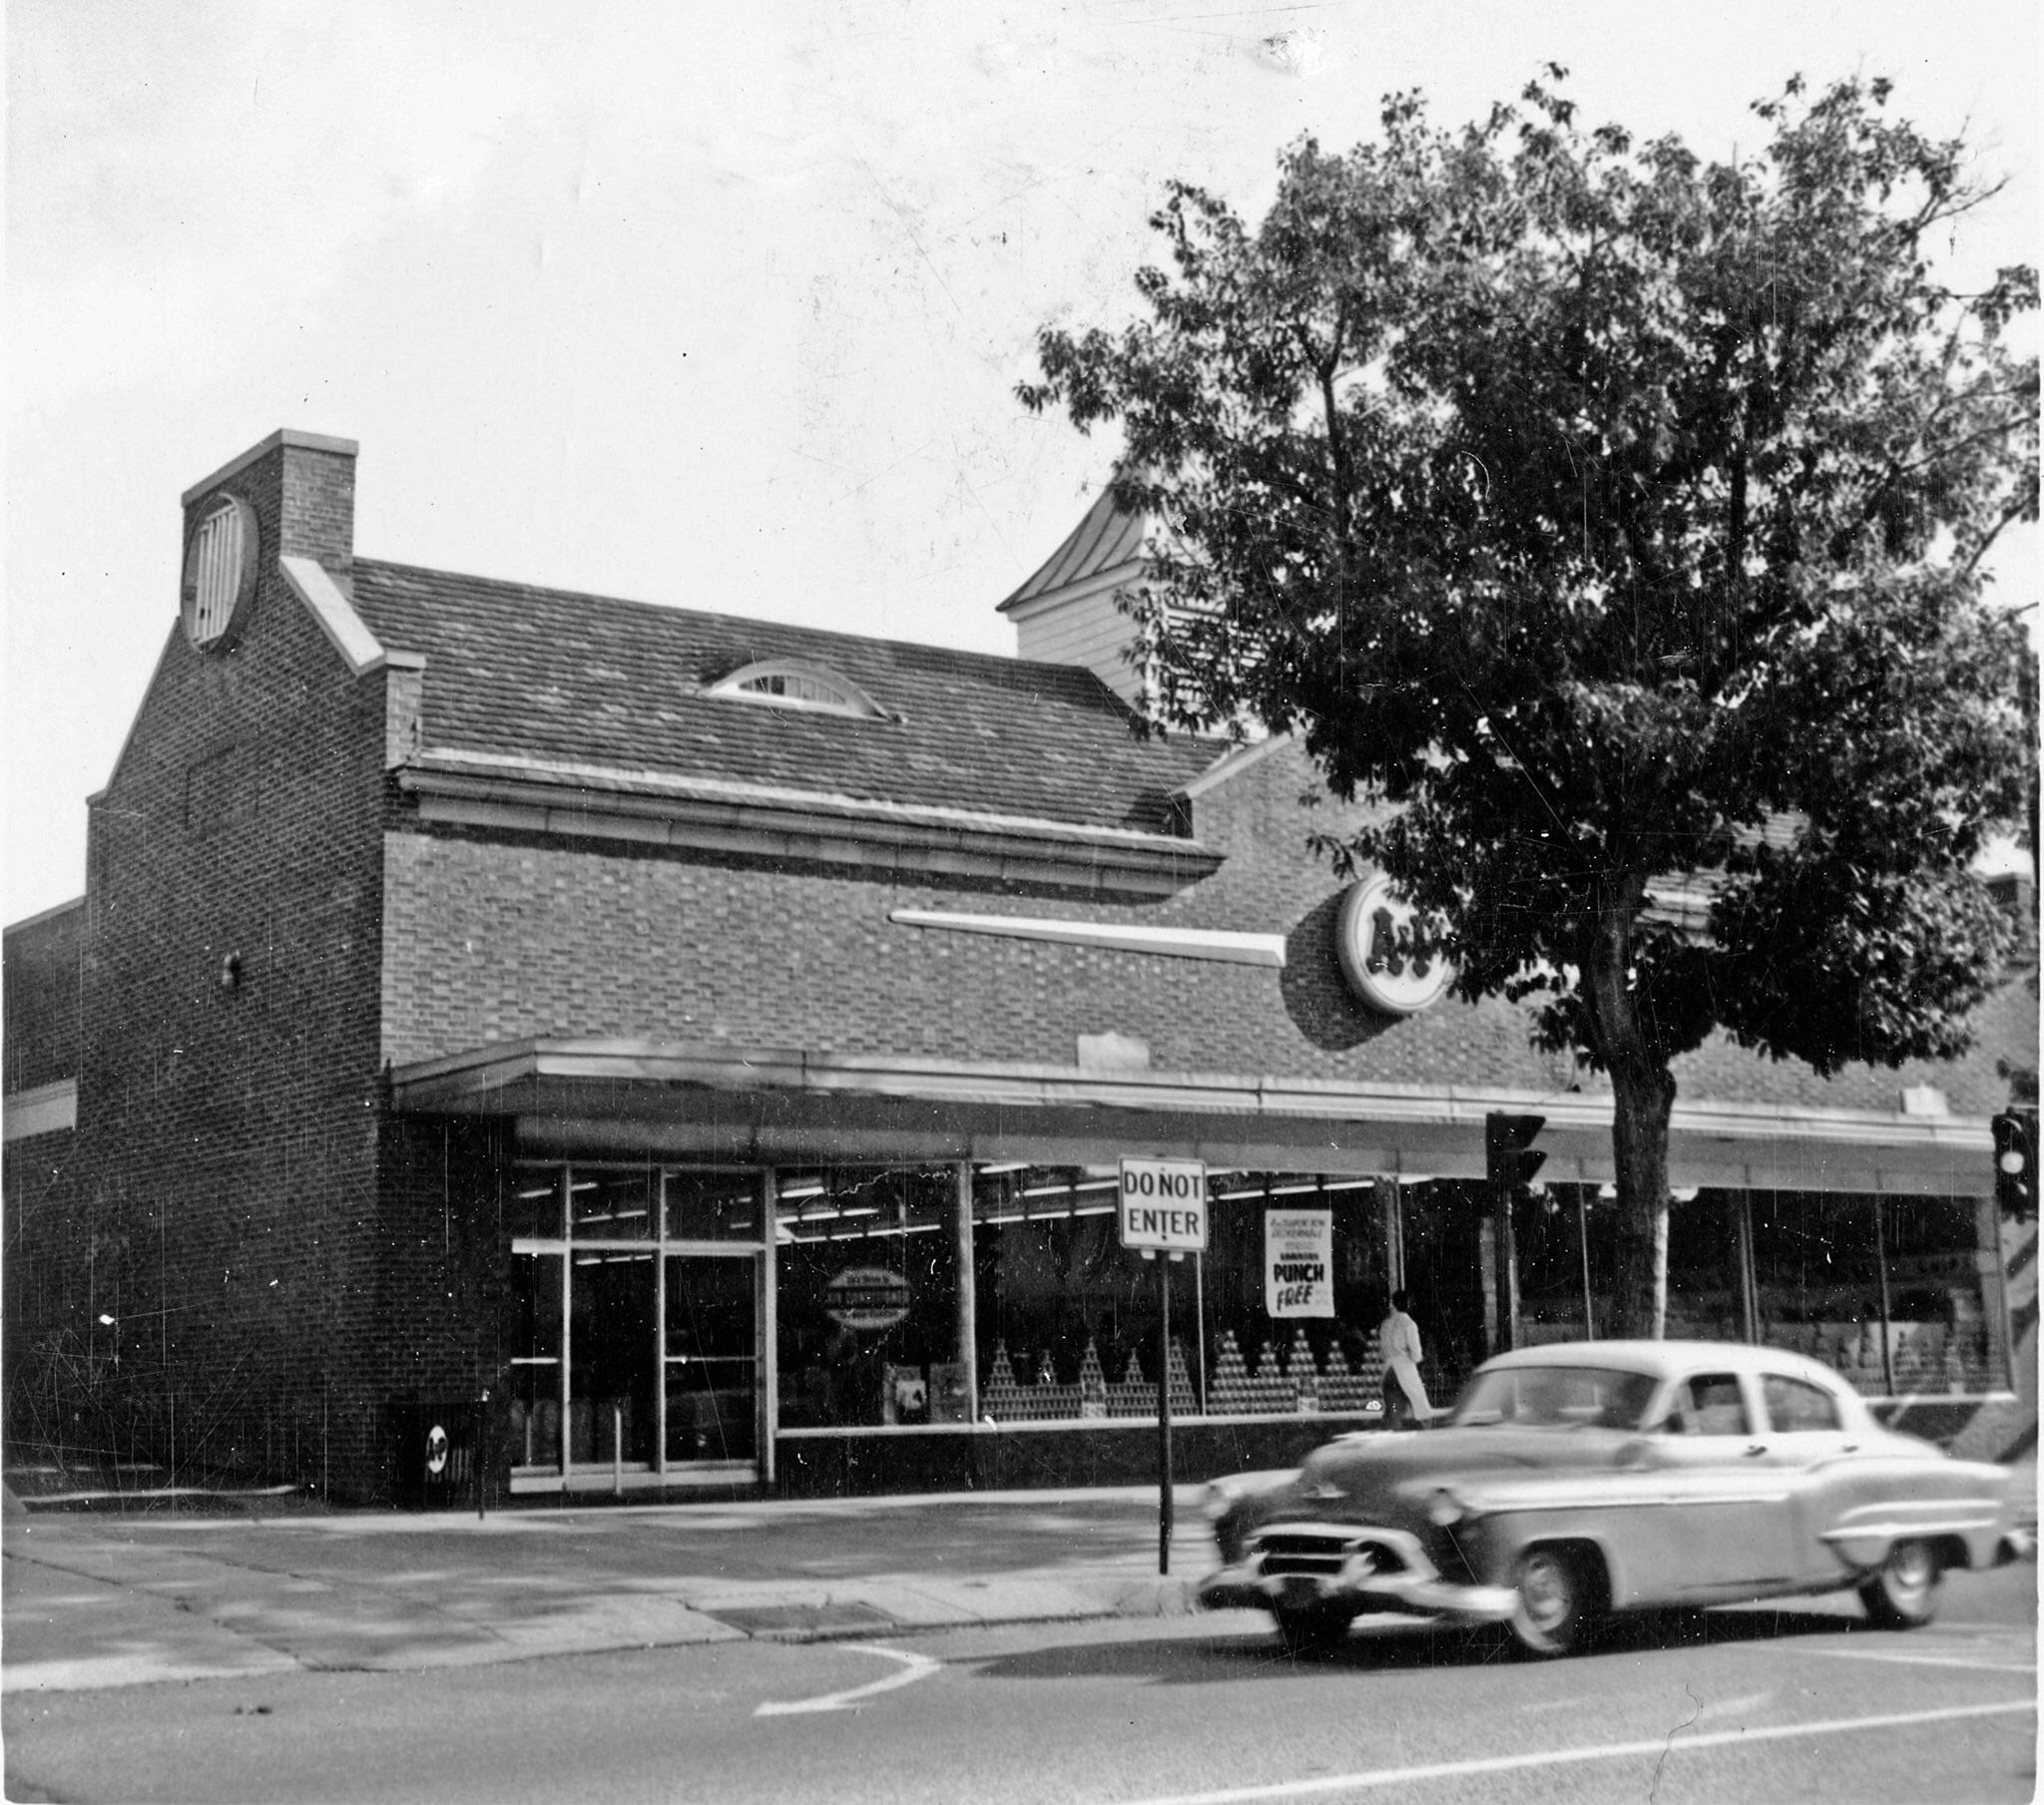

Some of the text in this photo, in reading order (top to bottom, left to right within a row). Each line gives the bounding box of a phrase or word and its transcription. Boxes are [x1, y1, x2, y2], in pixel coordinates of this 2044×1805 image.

[1124, 1171, 1201, 1199] DO NOT
[1129, 1208, 1199, 1235] ENTER
[1274, 1263, 1324, 1283] PUNCH
[1277, 1284, 1313, 1312] FREE
